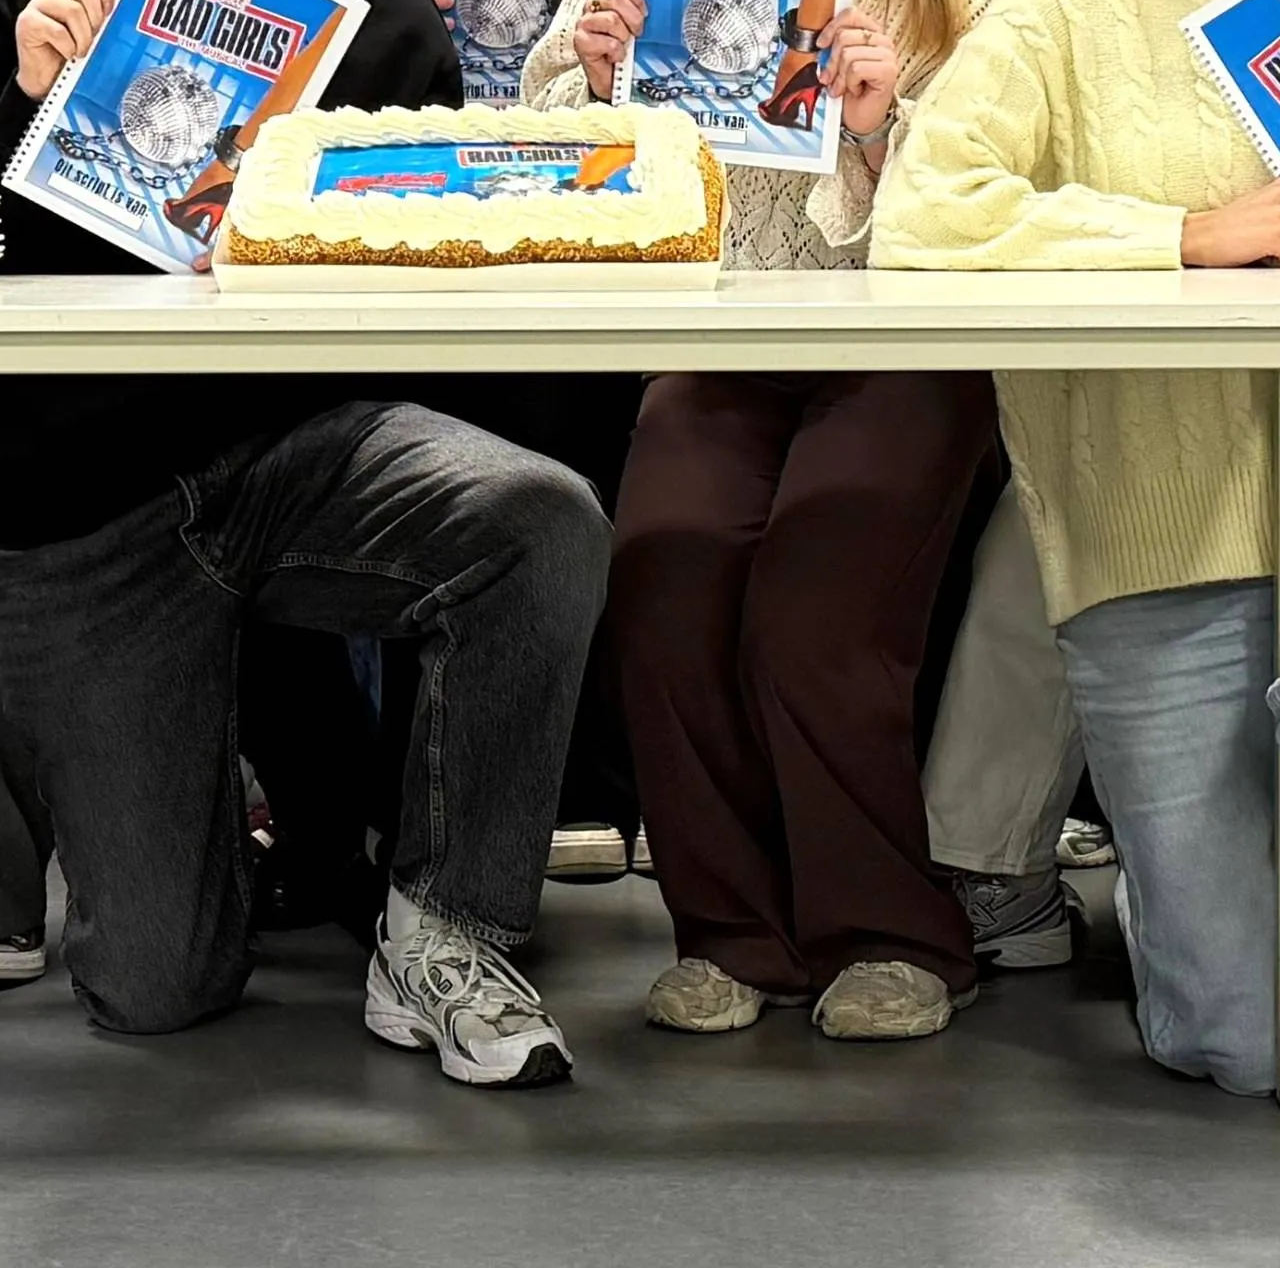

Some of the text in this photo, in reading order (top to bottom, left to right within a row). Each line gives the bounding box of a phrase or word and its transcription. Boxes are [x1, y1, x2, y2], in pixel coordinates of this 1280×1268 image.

[210, 7, 291, 70] GIRLS
[708, 111, 720, 126] is
[467, 147, 580, 163] BAD GIRLS
[54, 158, 73, 179] Dit
[74, 170, 111, 201] script
[110, 188, 125, 204] is
